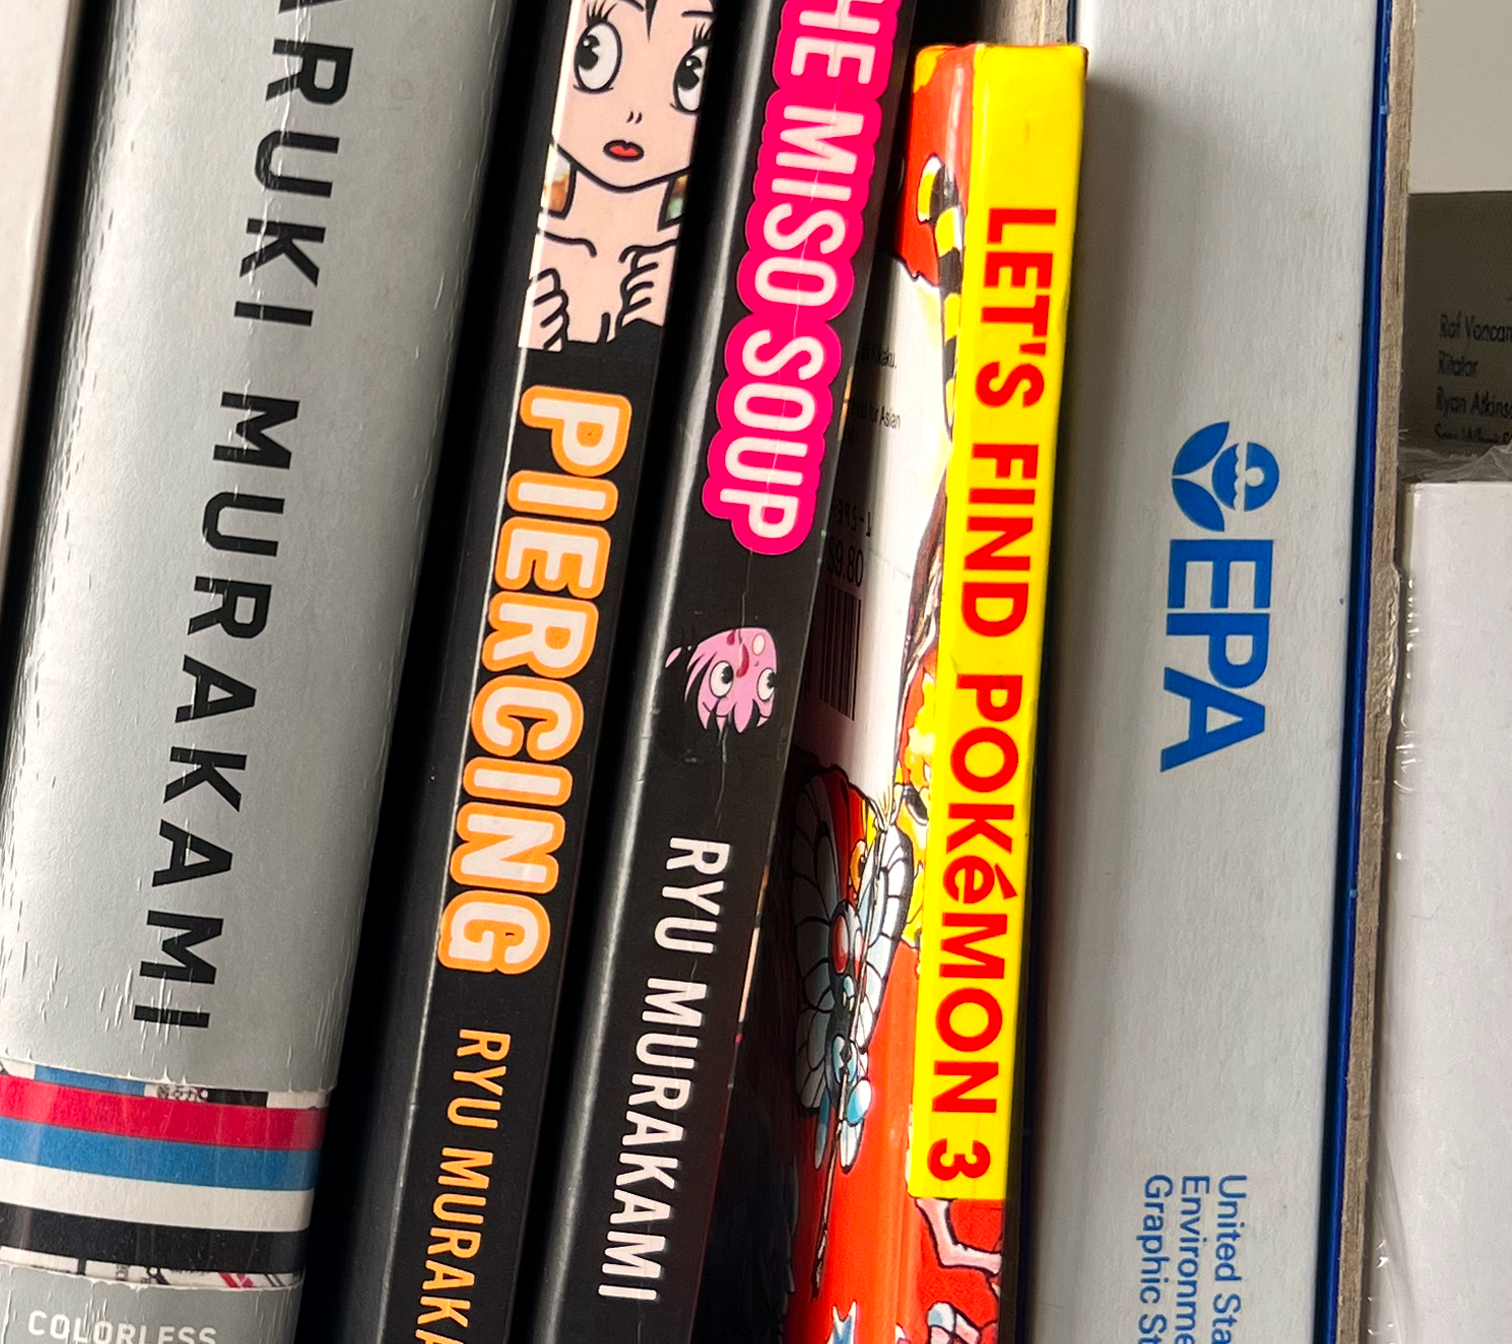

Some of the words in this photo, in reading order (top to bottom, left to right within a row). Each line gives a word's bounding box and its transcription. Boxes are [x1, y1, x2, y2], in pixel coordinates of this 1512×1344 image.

[754, 105, 865, 307] MISO
[977, 207, 1057, 408] LET'S
[1470, 388, 1512, 420] Atkins
[719, 329, 825, 539] SOUP
[963, 442, 1039, 638] FIND
[132, 391, 300, 1030] MURAKAMI
[438, 384, 633, 976] PIERCING
[1161, 538, 1274, 771] EPA
[654, 837, 731, 954] RYU
[446, 1029, 511, 1130] RYU
[597, 977, 708, 1301] MURAKAMI
[926, 1138, 992, 1182] 3
[1136, 1174, 1175, 1305] Graphic
[1214, 1174, 1247, 1283] United
